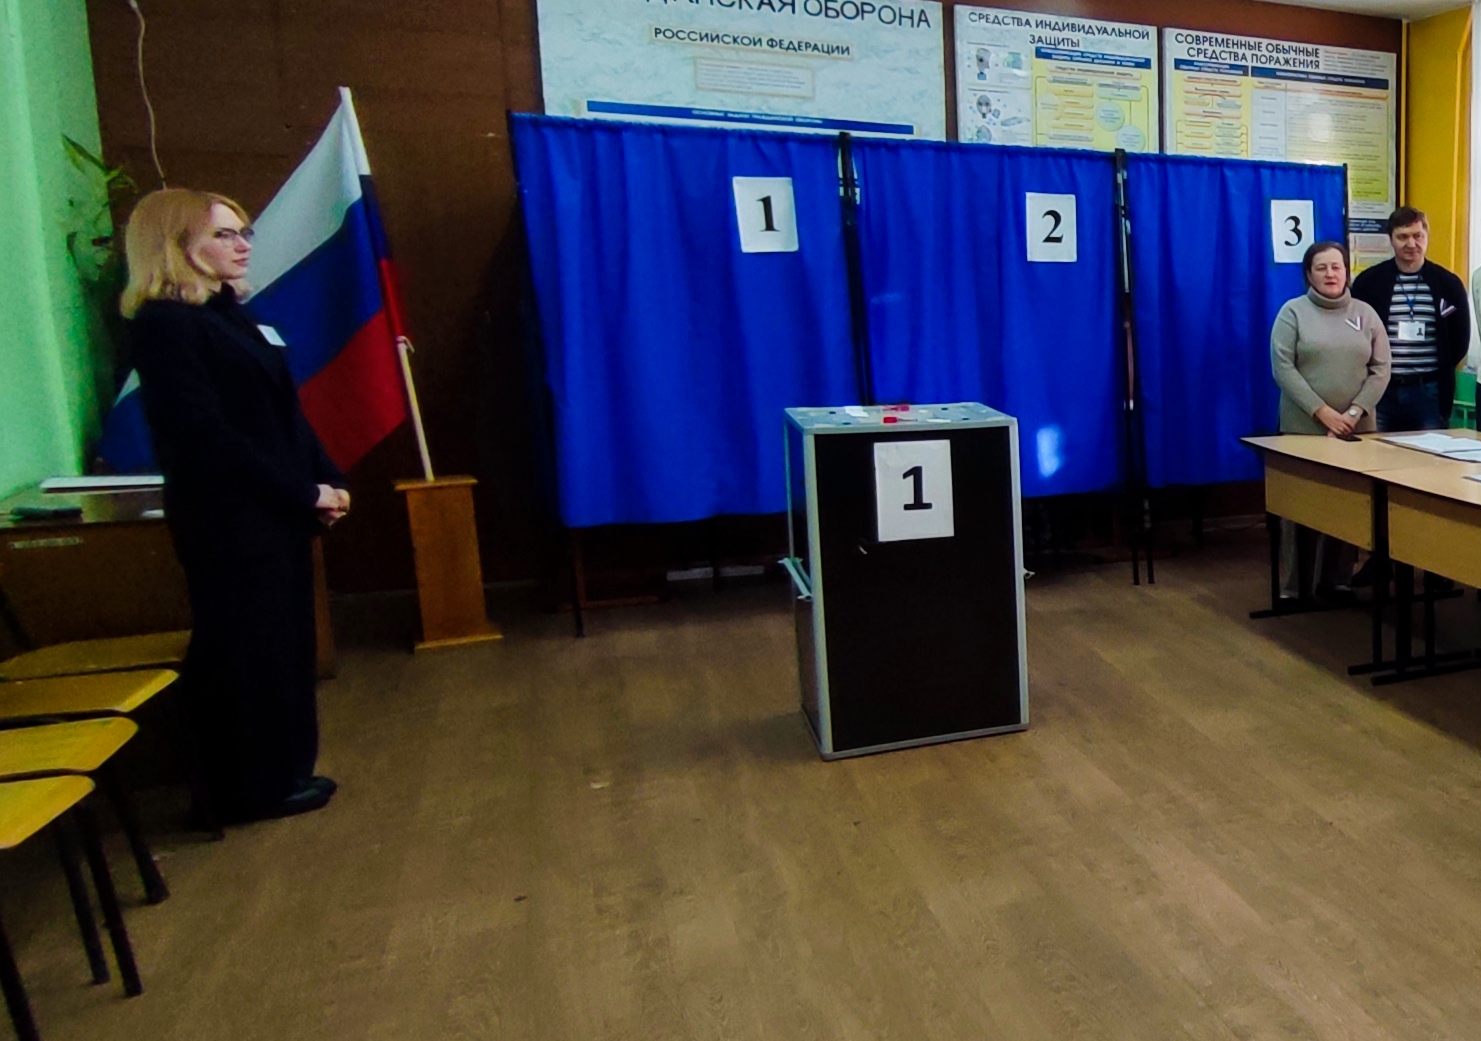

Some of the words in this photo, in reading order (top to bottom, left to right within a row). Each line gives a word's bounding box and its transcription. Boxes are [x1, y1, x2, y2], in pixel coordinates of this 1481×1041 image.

[803, 0, 932, 29] ОБОРОНА
[968, 11, 1032, 29] СРЕДСТВА
[1035, 19, 1150, 41] ИНДИВИДУАЛЬНОЙ
[766, 38, 850, 56] ФЕДЕРАЦИИ
[1029, 34, 1081, 49] ЗАЩИТЫ
[1174, 32, 1263, 52] СОВРЕМЕННЫЕ
[1265, 42, 1320, 58] ОБЫЧНЫЕ
[1187, 47, 1248, 63] СРЕДСТВА
[1251, 53, 1320, 70] ПОРАЖЕНИЯ
[755, 195, 780, 233] 1
[1041, 209, 1064, 244] 2
[1284, 215, 1303, 247] 3
[902, 465, 933, 511] 1
